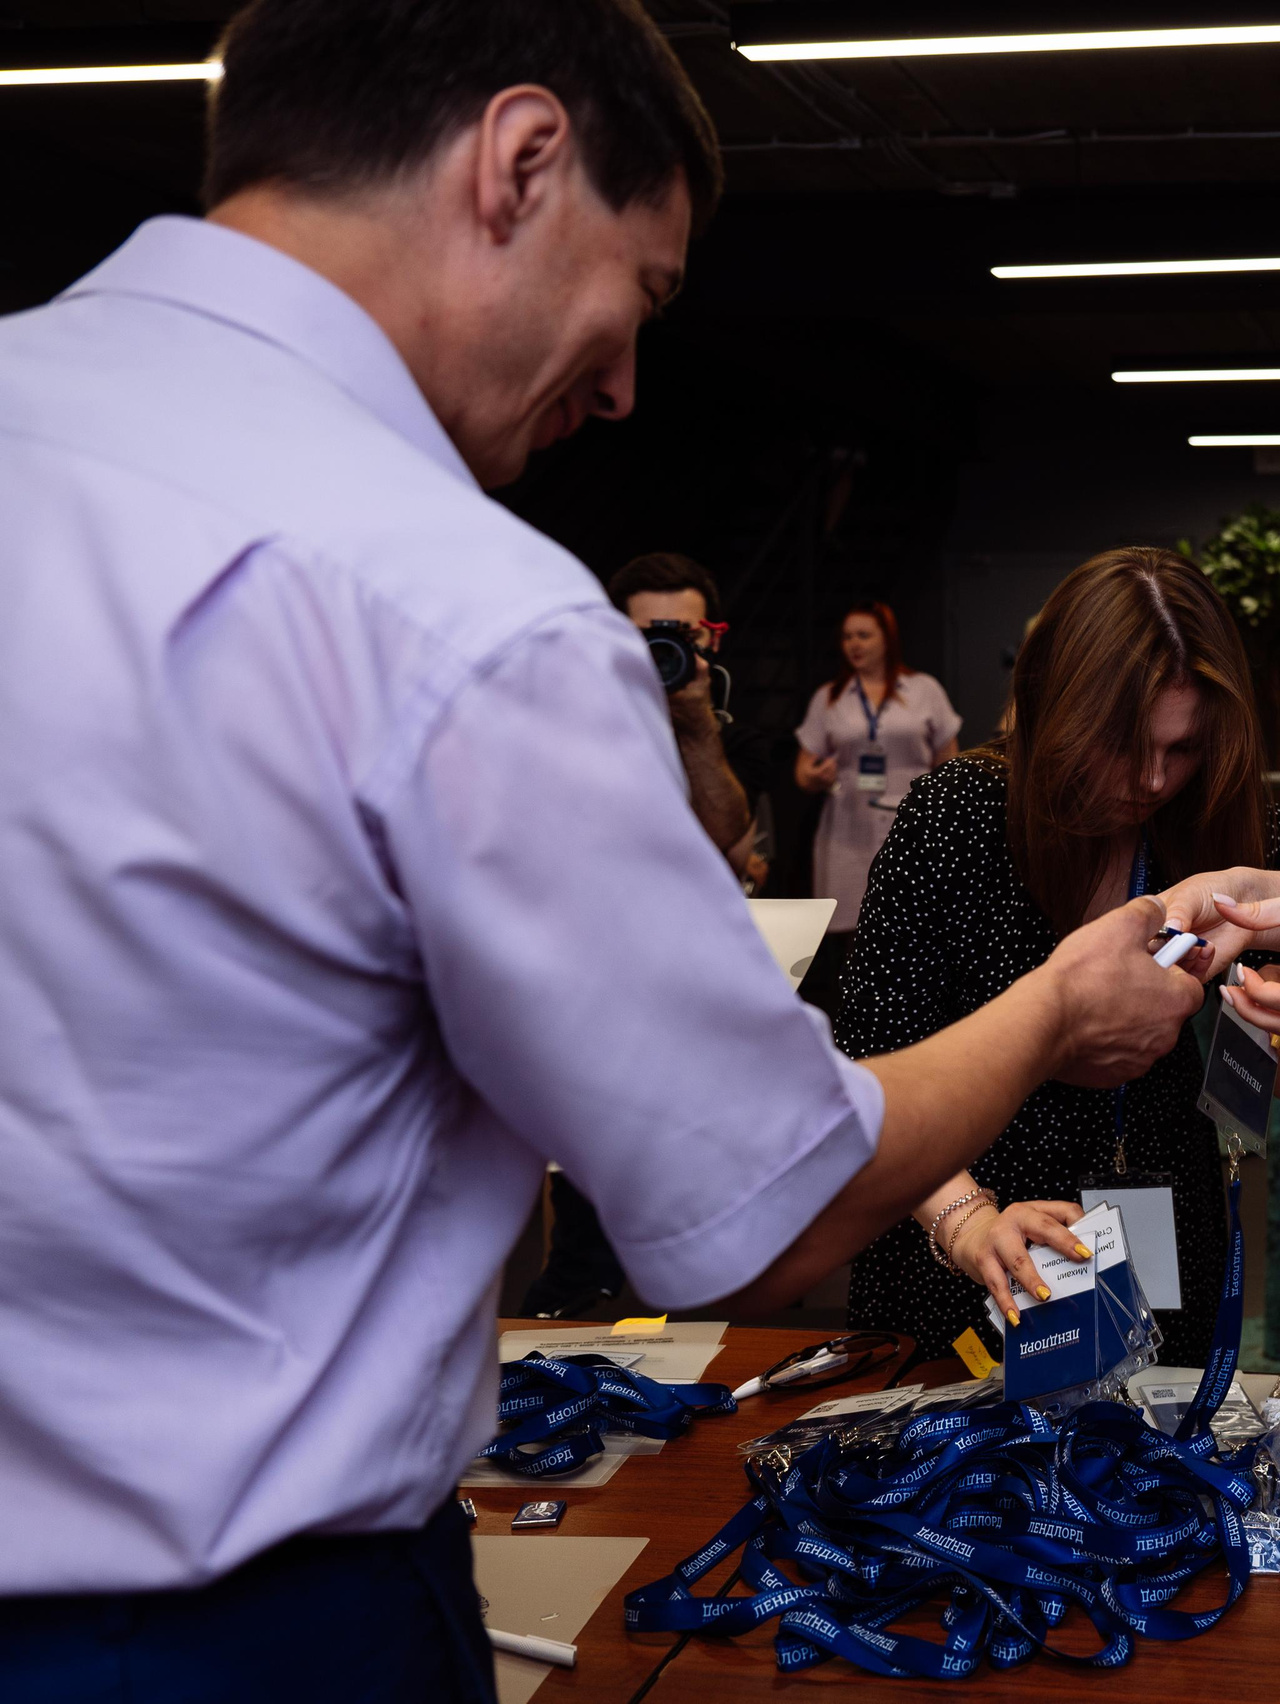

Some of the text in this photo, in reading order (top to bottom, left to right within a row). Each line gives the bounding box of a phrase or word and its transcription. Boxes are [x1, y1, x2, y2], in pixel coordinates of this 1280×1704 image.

[1223, 1049, 1262, 1093] ЛЕНДЛОРД
[1057, 1265, 1088, 1281] Михаил
[1231, 1231, 1241, 1297] ЛЕНДЛОРД
[1020, 1328, 1080, 1355] ЛЕНДЛОРД
[1206, 1349, 1234, 1408] ЛЕНДЛОРД
[546, 1392, 598, 1424] ЕНДЛОРД
[955, 1427, 1007, 1450] ЛЕНДЛОРД
[947, 1515, 1003, 1530] ЛЕНДЛОРД
[1097, 1501, 1160, 1525] ЛЕНДЛОРД
[911, 1526, 975, 1557] ЛЕНДЛОРД
[1028, 1521, 1084, 1545] ЛЕНДЛОРД
[1136, 1517, 1200, 1551] ЛЕНДЛОРД
[680, 1539, 726, 1577] ЛЕНДЛОРД
[1027, 1565, 1096, 1605] ЛЕНДЛОРД
[848, 1623, 899, 1652] ЛЕНДЛОРД
